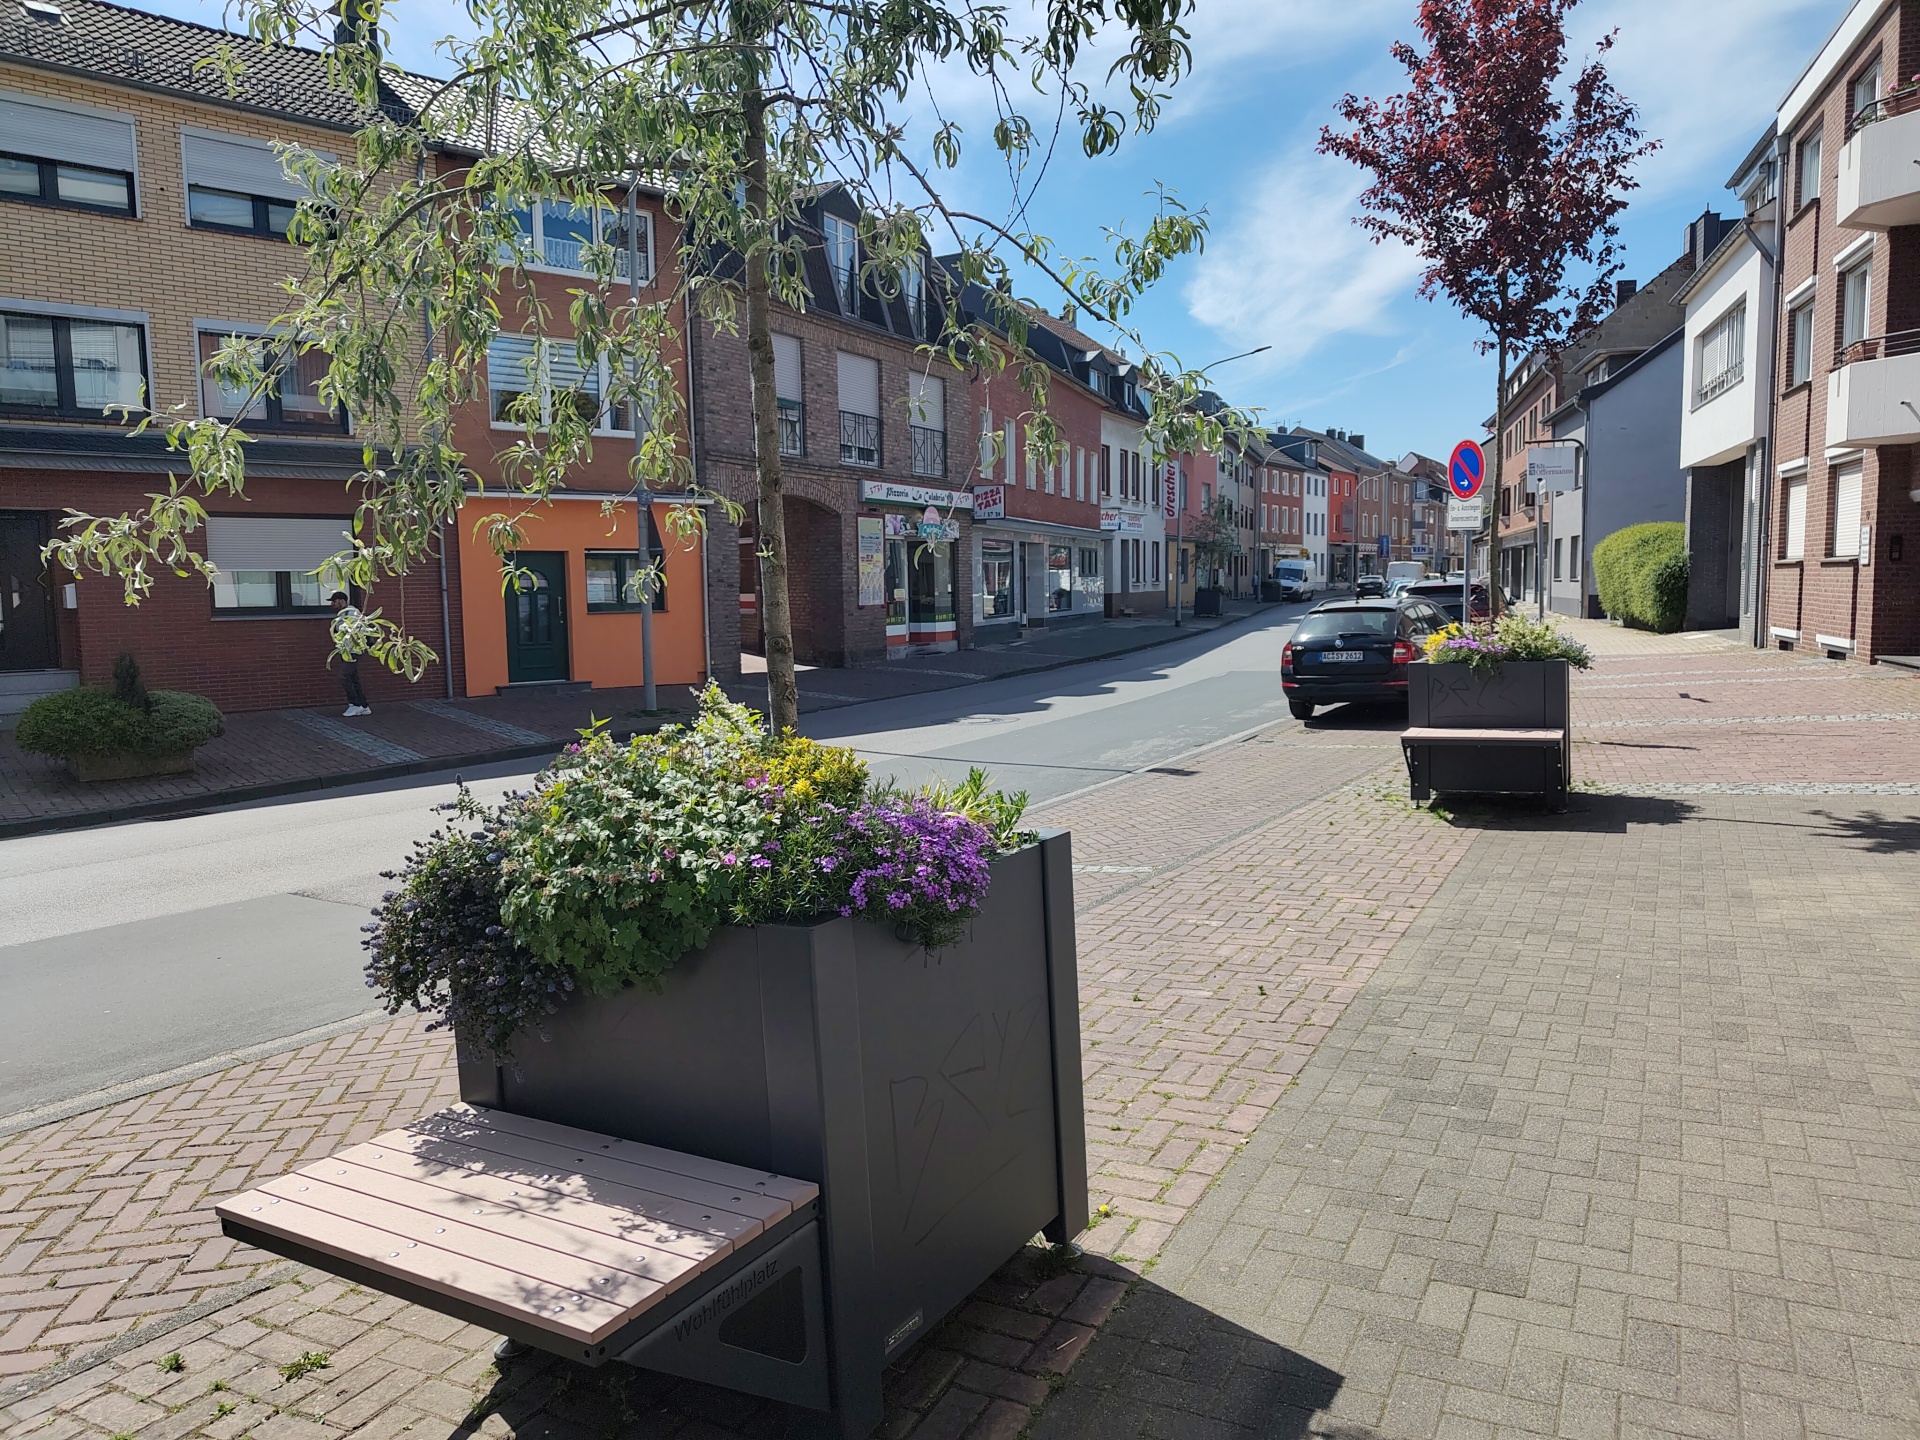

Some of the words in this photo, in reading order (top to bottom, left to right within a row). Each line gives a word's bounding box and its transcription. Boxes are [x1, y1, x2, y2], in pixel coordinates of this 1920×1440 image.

[885, 486, 909, 499] Pizzeria
[975, 486, 1002, 503] PIZZA
[1164, 463, 1176, 518] drescher
[977, 496, 1002, 511] TAXI
[1101, 511, 1118, 520] cher
[1345, 651, 1362, 660] 2612
[673, 1259, 779, 1342] Wohlfühlplatz
